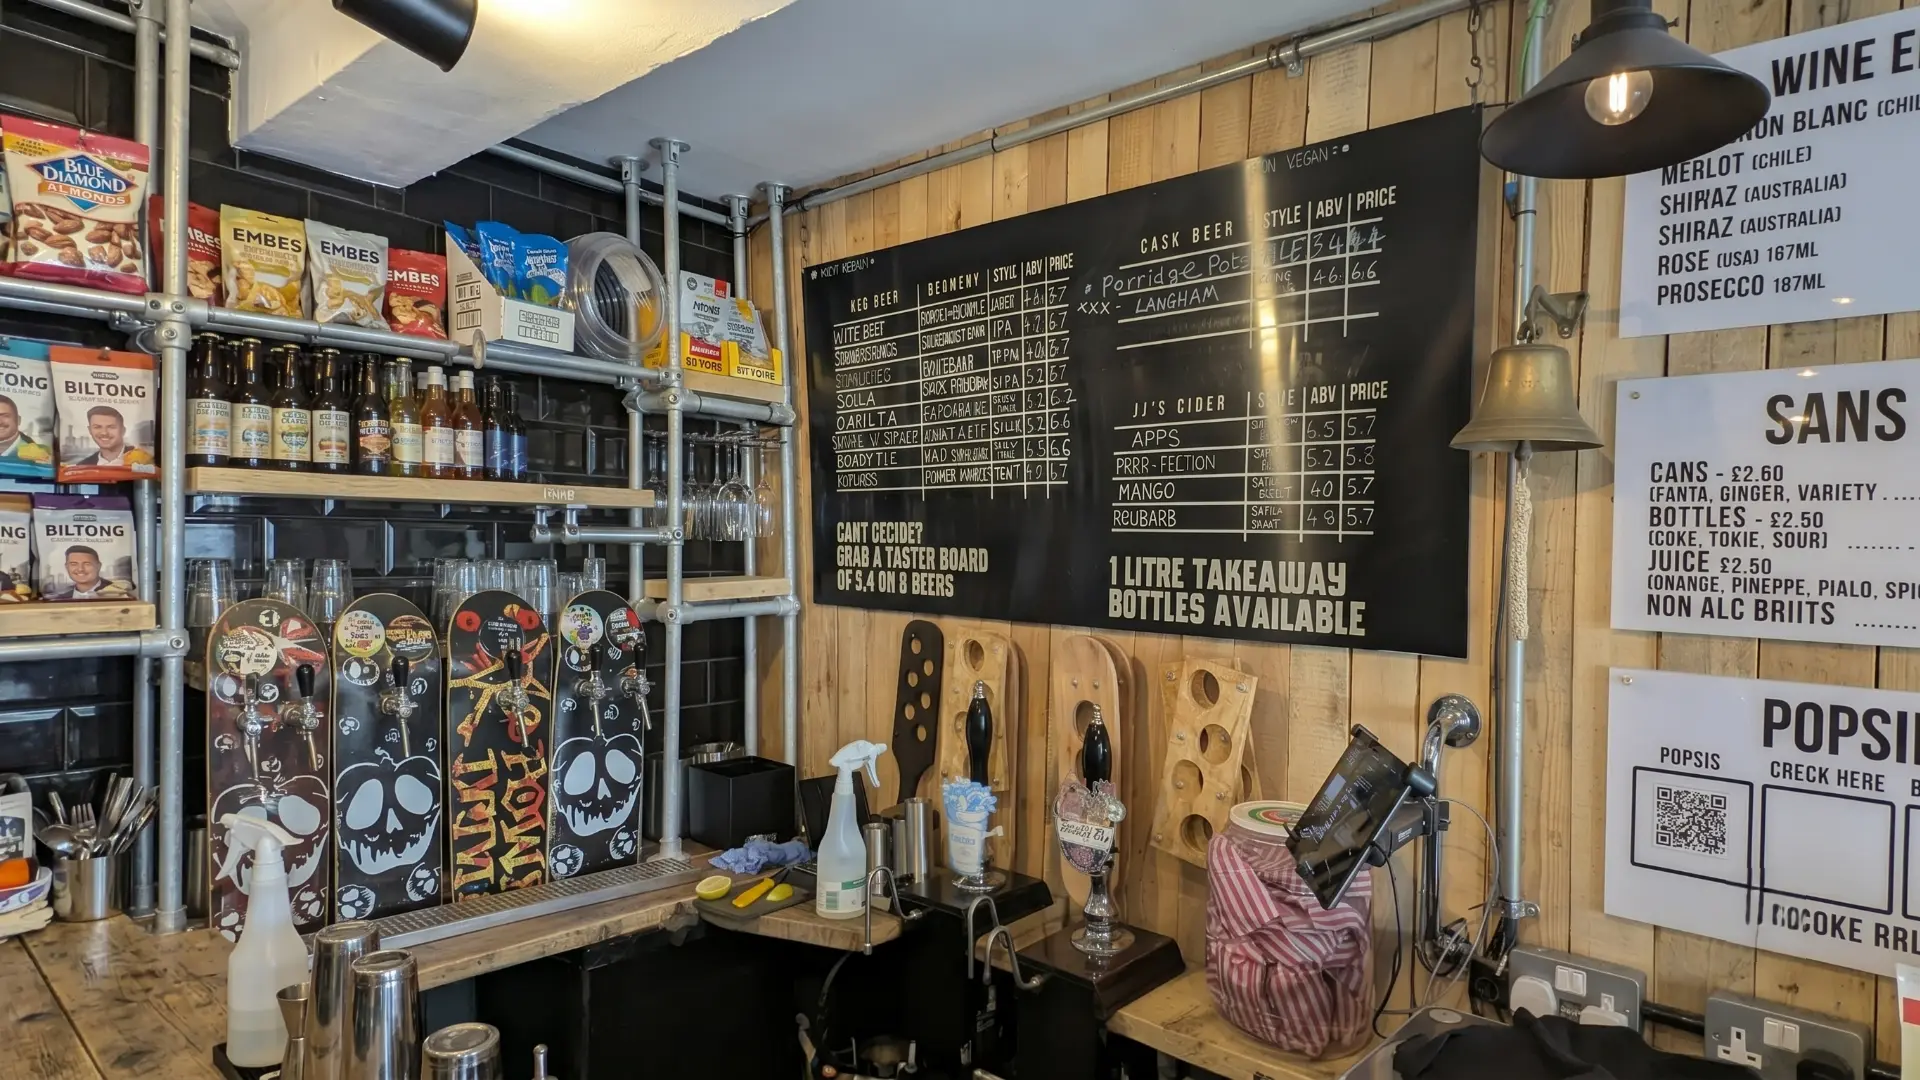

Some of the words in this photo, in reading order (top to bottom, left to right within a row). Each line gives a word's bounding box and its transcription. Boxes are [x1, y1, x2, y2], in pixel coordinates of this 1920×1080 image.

[1771, 37, 1876, 97] WINE
[1891, 28, 1920, 75] E
[1792, 99, 1868, 133] BLANC
[64, 158, 104, 178] BLUE
[1286, 147, 1329, 169] VEGAN
[1661, 152, 1746, 186] MERLOT
[1752, 145, 1812, 171] (CHILE)
[42, 165, 126, 192] DIAMOND
[1744, 172, 1847, 203] (AUSTRALIA)
[48, 183, 126, 205] ALMONDS
[1356, 186, 1397, 211] PRICE
[1263, 205, 1301, 229] STYLE
[1316, 197, 1343, 220] ABV
[1140, 231, 1180, 254] CASK
[1192, 220, 1233, 243] BEER
[1659, 215, 1733, 246] SHIRAZ
[1740, 206, 1841, 235] (AUSTRALIA)
[233, 228, 302, 252] EMBES
[320, 240, 380, 264] EMBES
[1026, 259, 1043, 276] ABV
[1049, 253, 1073, 272] PRICE
[1657, 249, 1710, 276] ROSE
[1717, 248, 1759, 269] (USA)
[1767, 241, 1819, 263] 167ML
[387, 270, 440, 287] EMBES
[1657, 274, 1764, 306] PROSECCO
[1773, 273, 1826, 294] 187ML
[850, 297, 868, 313] KEG
[874, 290, 899, 308] BEER
[1135, 284, 1220, 314] LANGHAM
[993, 320, 1013, 338] IPA
[64, 380, 146, 398] BILTONG
[1310, 385, 1336, 404] ABV
[1350, 381, 1388, 401] PRICE
[1133, 400, 1165, 418] JJ'S
[1177, 395, 1226, 413] CIDER
[1765, 388, 1907, 445] SANS
[1131, 428, 1181, 448] APPS
[1650, 461, 1708, 483] CANS
[1731, 465, 1784, 482] £2.60
[1119, 482, 1175, 500] MANGO
[1650, 485, 1713, 503] (FANTA,
[1720, 485, 1790, 503] GINGER,
[1798, 483, 1878, 501] VARIETY
[1649, 506, 1746, 528] BOTTLES
[1770, 511, 1824, 528] £2.50
[45, 524, 124, 537] BILTONG
[837, 522, 869, 543] CANT
[1648, 530, 1703, 548] (COKE,
[1709, 530, 1765, 549] TOKIE,
[1772, 531, 1828, 550] SOUR)
[837, 545, 870, 568] GRAB
[872, 547, 882, 568] A
[885, 546, 935, 570] TASTER
[939, 547, 989, 573] BOARD
[1648, 550, 1710, 572] JUICE
[1720, 557, 1772, 574] £2.50
[837, 569, 852, 591] OF
[878, 571, 895, 594] ON
[911, 572, 954, 598] BEERS
[1109, 556, 1117, 586] 1
[1124, 556, 1185, 589] LITRE
[1192, 557, 1347, 597] TAKEAWAY
[1731, 576, 1811, 598] PINEPPE,
[1818, 579, 1878, 600] PIALO,
[1885, 581, 1920, 600] SPI
[1108, 588, 1205, 625] BOTTLES
[1213, 593, 1366, 637] AVAILABLE
[1647, 594, 1691, 618] NON
[1700, 596, 1745, 621] ALC
[1754, 598, 1836, 625] BRIITS
[1763, 698, 1920, 765] POPSI
[1660, 747, 1721, 771] POPSIS
[1770, 760, 1829, 785] CRECK
[1837, 770, 1886, 793] HERE
